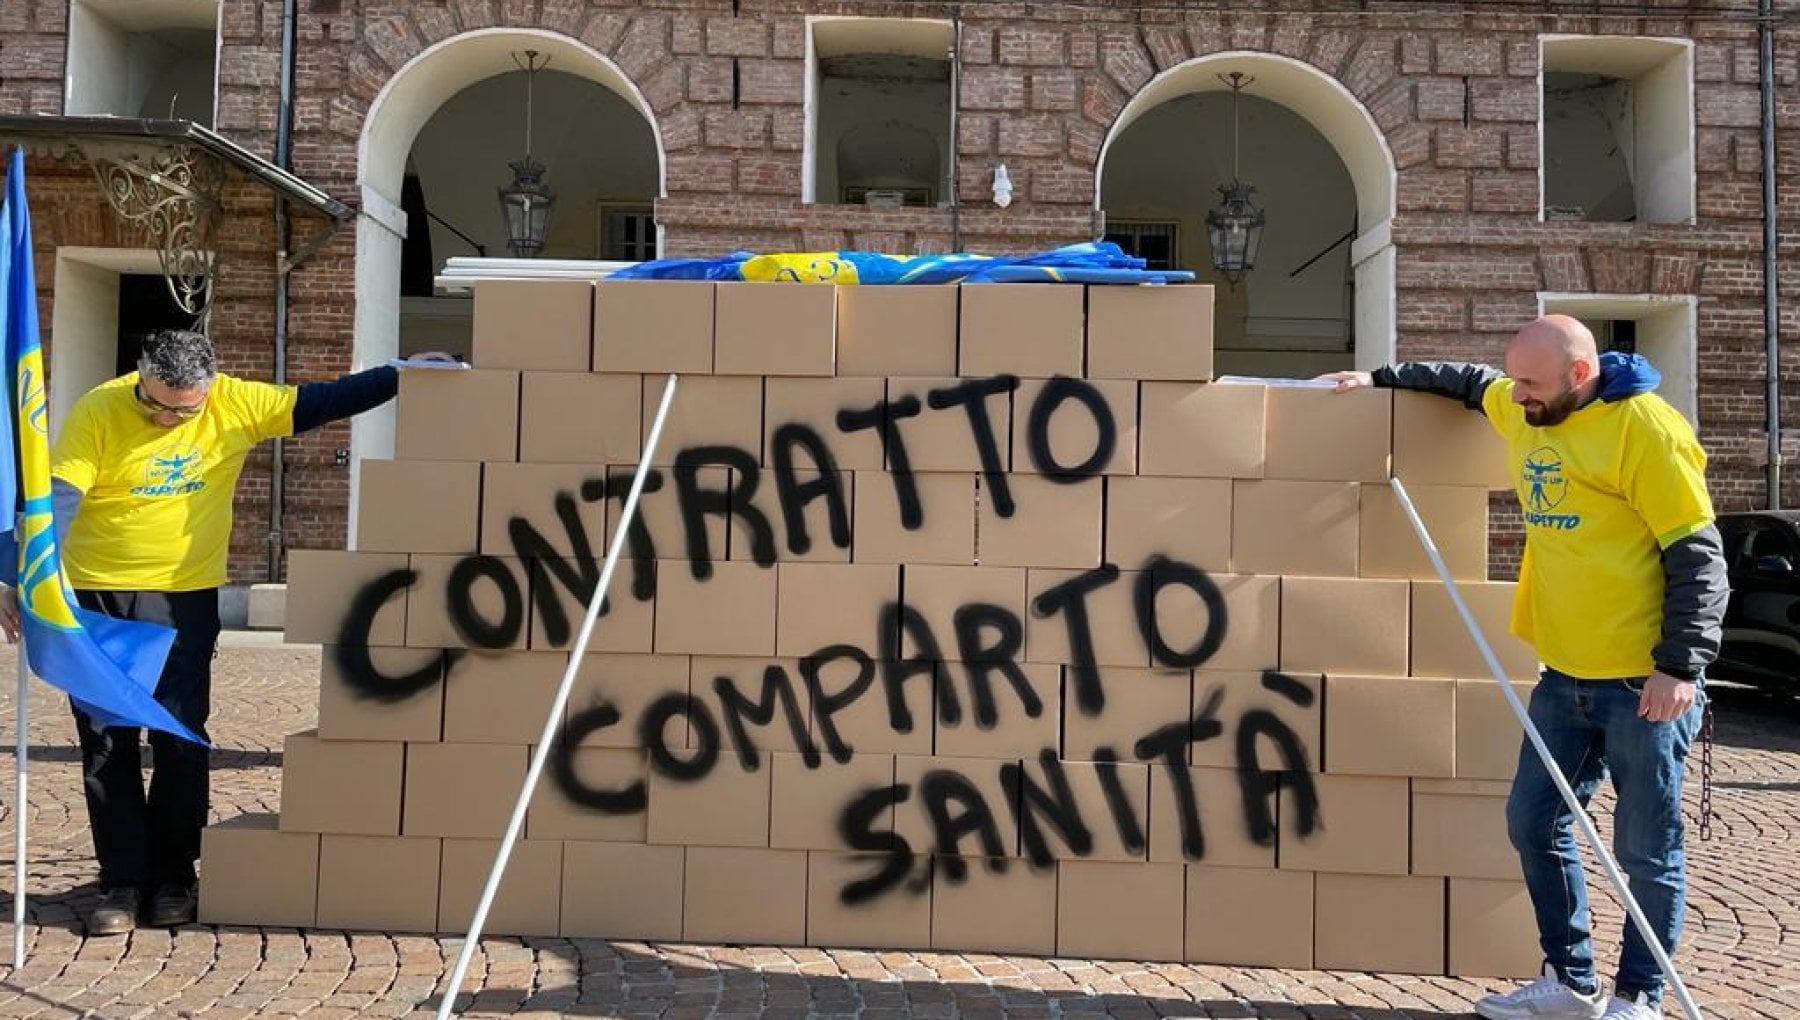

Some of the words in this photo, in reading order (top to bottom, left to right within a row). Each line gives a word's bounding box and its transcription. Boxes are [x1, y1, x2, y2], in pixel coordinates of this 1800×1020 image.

[336, 374, 1117, 704] CONTRATTO
[550, 554, 1229, 816] COMPARTO
[838, 668, 1322, 906] SANITÀ
